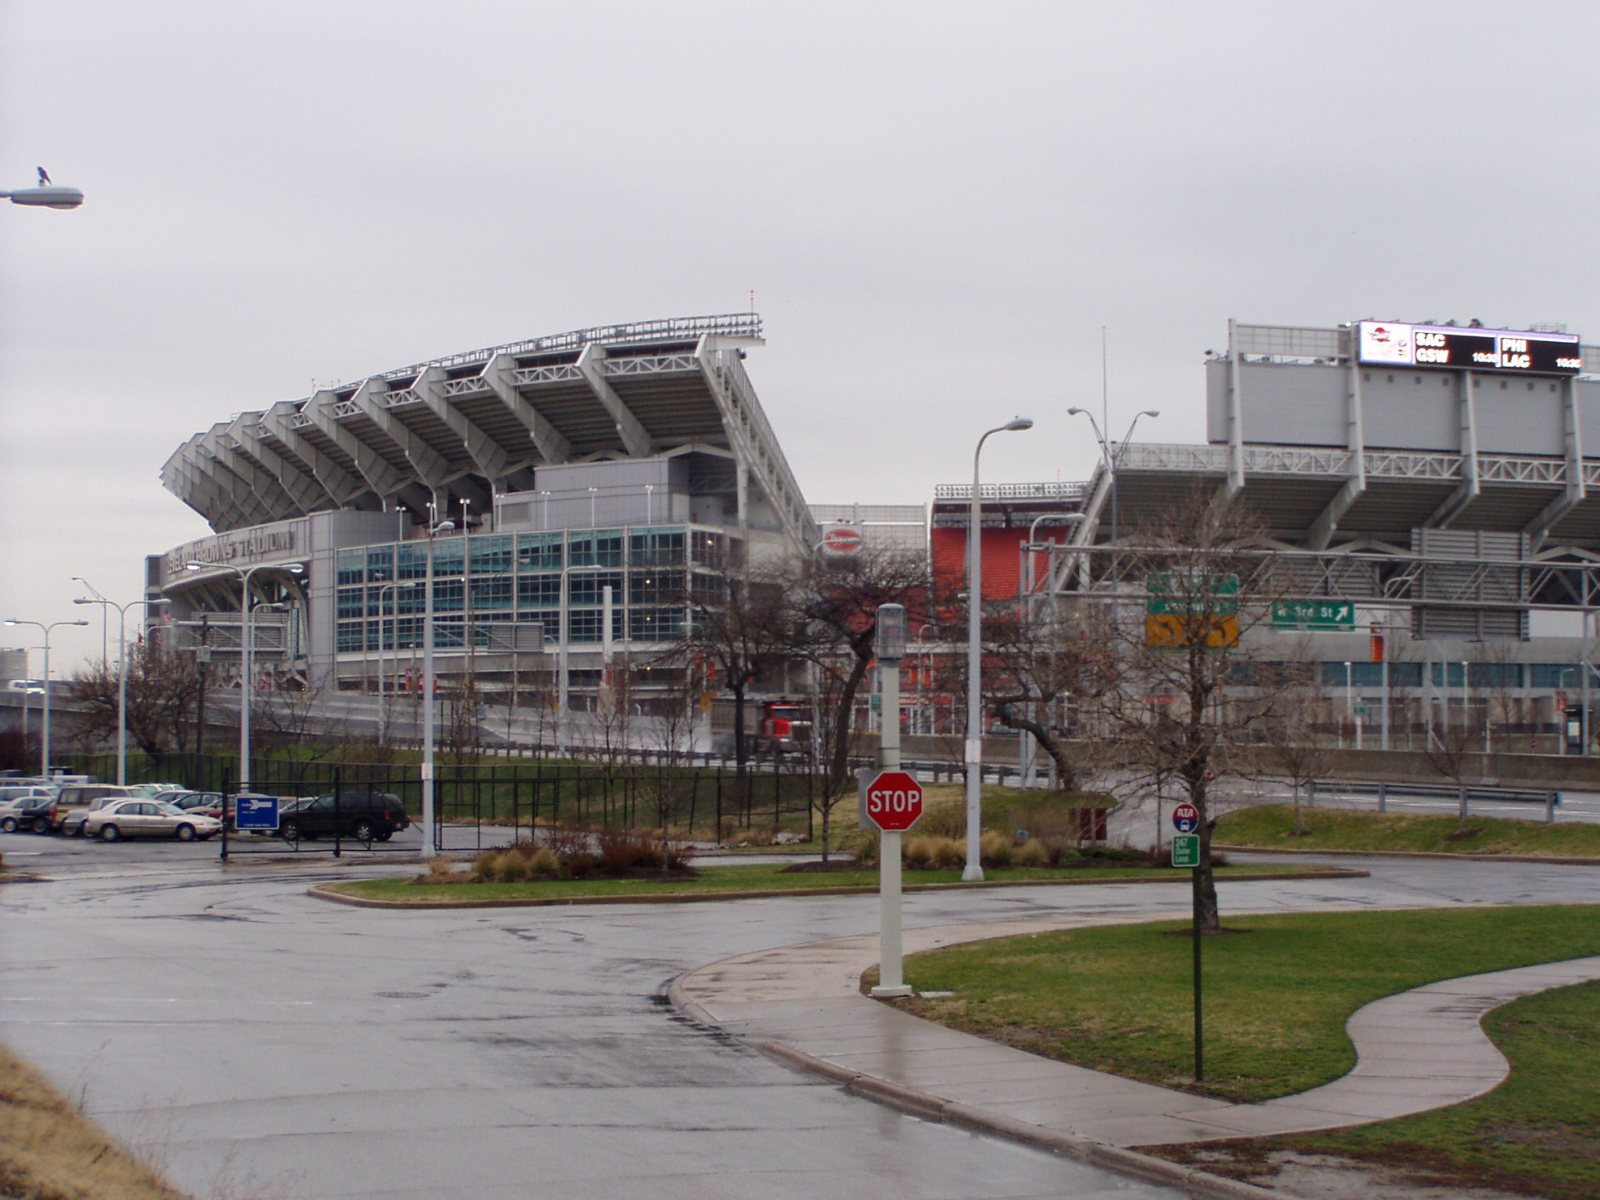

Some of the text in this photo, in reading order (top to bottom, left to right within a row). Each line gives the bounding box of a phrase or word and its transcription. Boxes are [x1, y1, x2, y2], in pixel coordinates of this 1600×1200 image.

[1416, 333, 1445, 348] SAC
[1502, 339, 1527, 353] PHI
[1416, 348, 1450, 364] GSW
[1502, 354, 1530, 369] LAC
[1320, 607, 1334, 618] St
[870, 790, 920, 813] STOP
